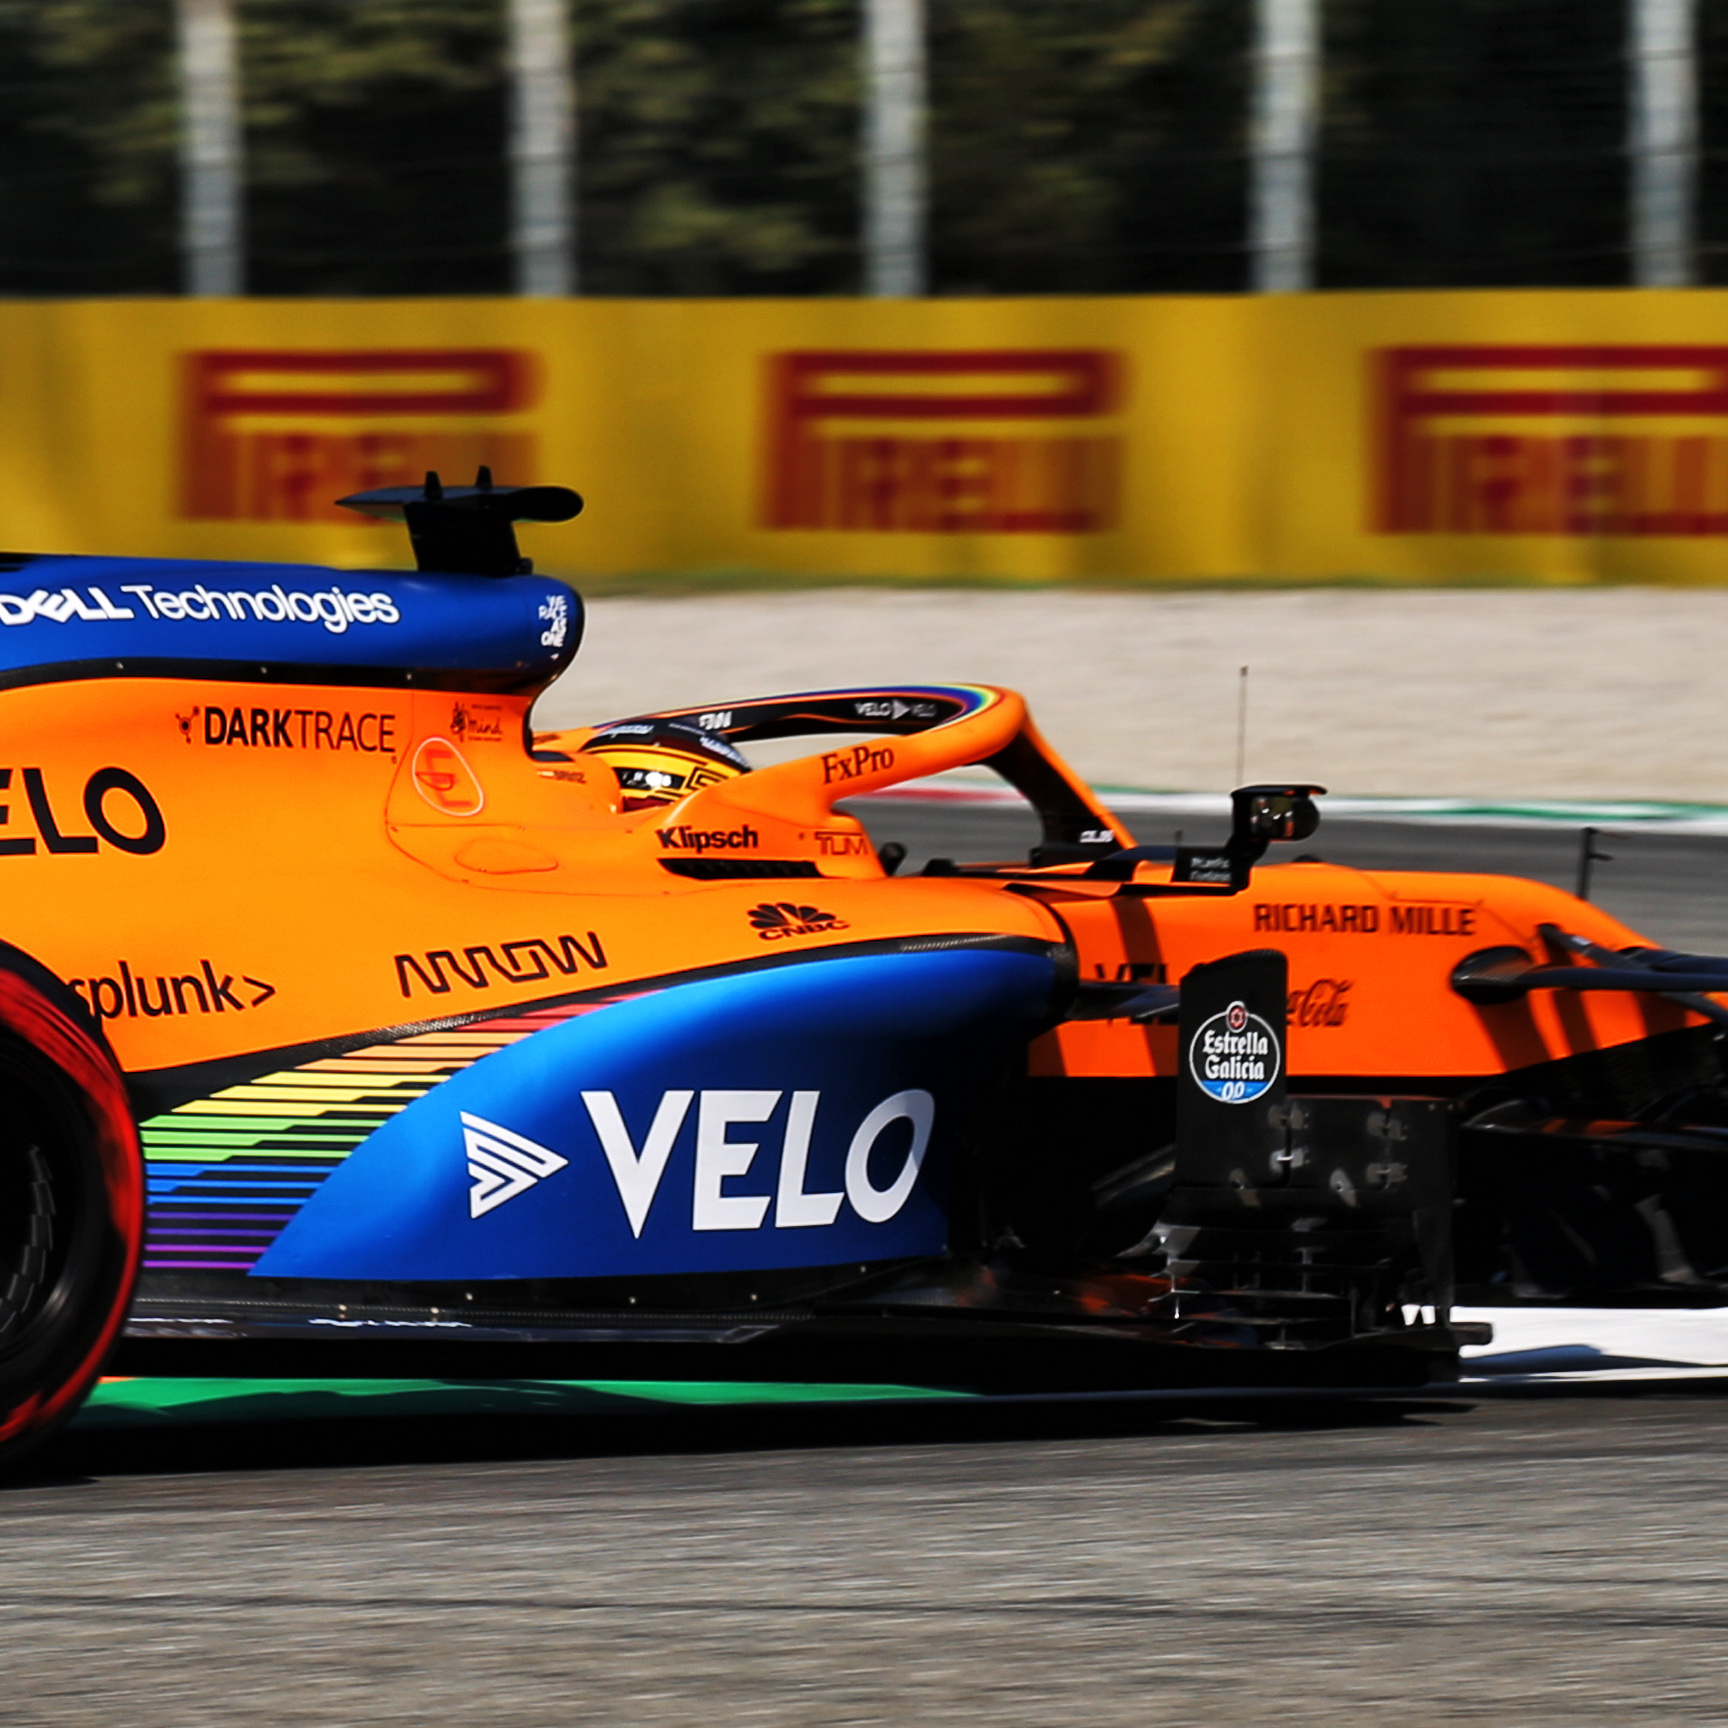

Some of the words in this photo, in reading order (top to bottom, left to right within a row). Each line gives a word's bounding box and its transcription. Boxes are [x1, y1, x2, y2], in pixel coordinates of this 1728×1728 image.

[758, 347, 1127, 533] PIRELLI
[120, 584, 401, 633] Technologies
[854, 702, 892, 716] VELO
[204, 706, 397, 753] DARKTRACE
[820, 745, 895, 785] FxPro
[656, 825, 759, 854] Klipsch
[758, 920, 851, 941] CNBC
[1253, 903, 1379, 933] RICHARD
[1388, 906, 1477, 936] MILLE
[1202, 1029, 1269, 1055] Estrella
[1204, 1055, 1265, 1080] Galicia
[580, 1088, 935, 1239] VELO
